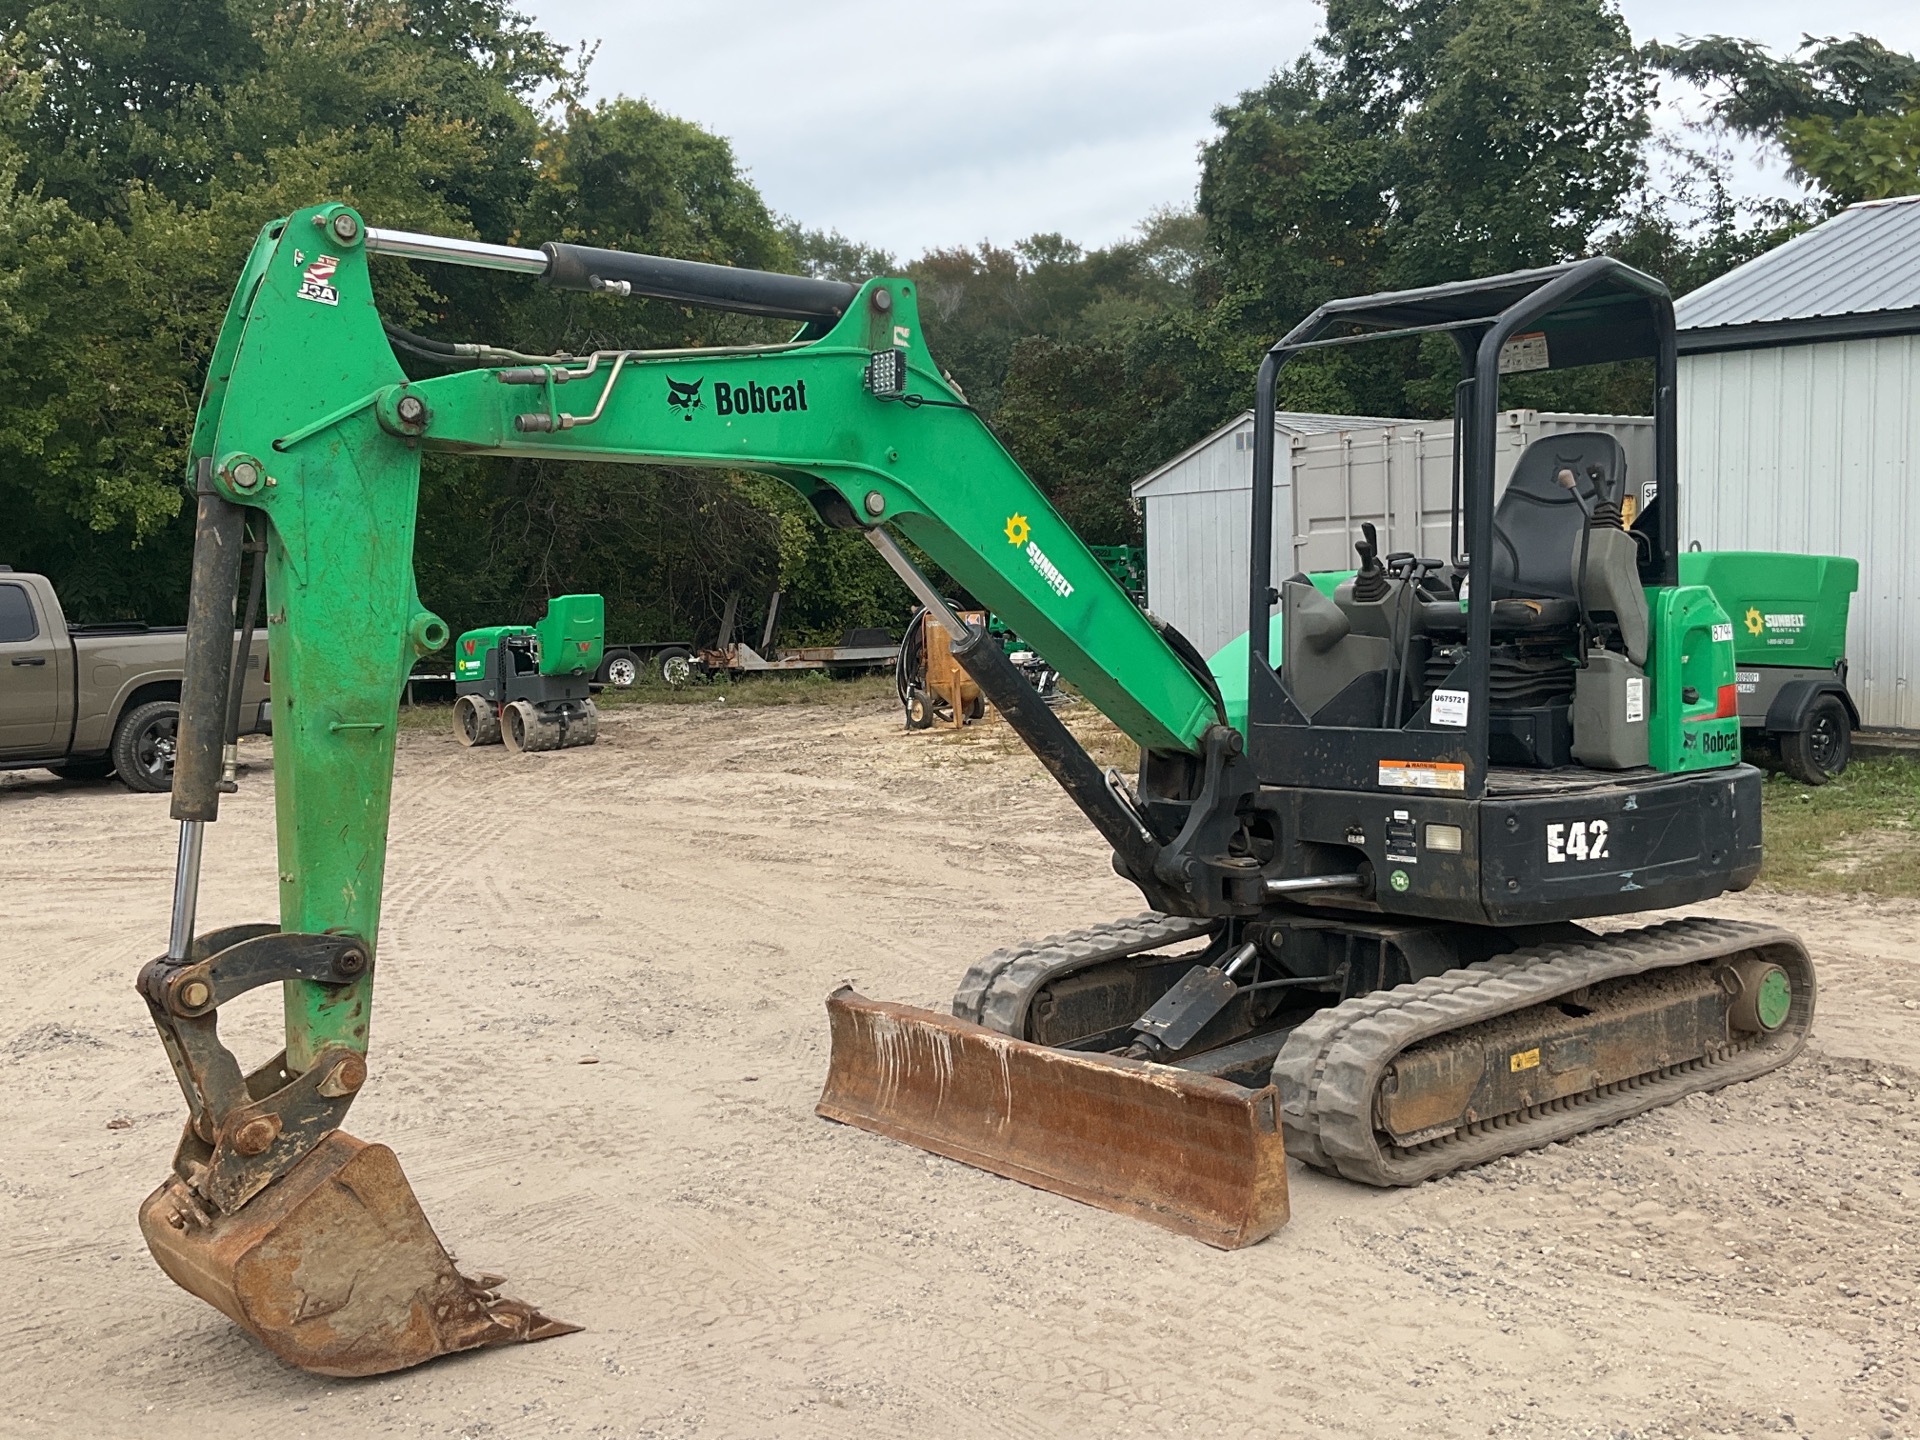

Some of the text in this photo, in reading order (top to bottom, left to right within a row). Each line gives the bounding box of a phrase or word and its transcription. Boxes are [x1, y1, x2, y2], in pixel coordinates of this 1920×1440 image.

[714, 380, 808, 416] Bobcat
[1026, 541, 1075, 598] SUNBELT
[1028, 558, 1062, 597] RENTALS
[1765, 614, 1804, 627] SUNBELT
[1434, 695, 1466, 703] U675721
[1547, 820, 1609, 863] E42
